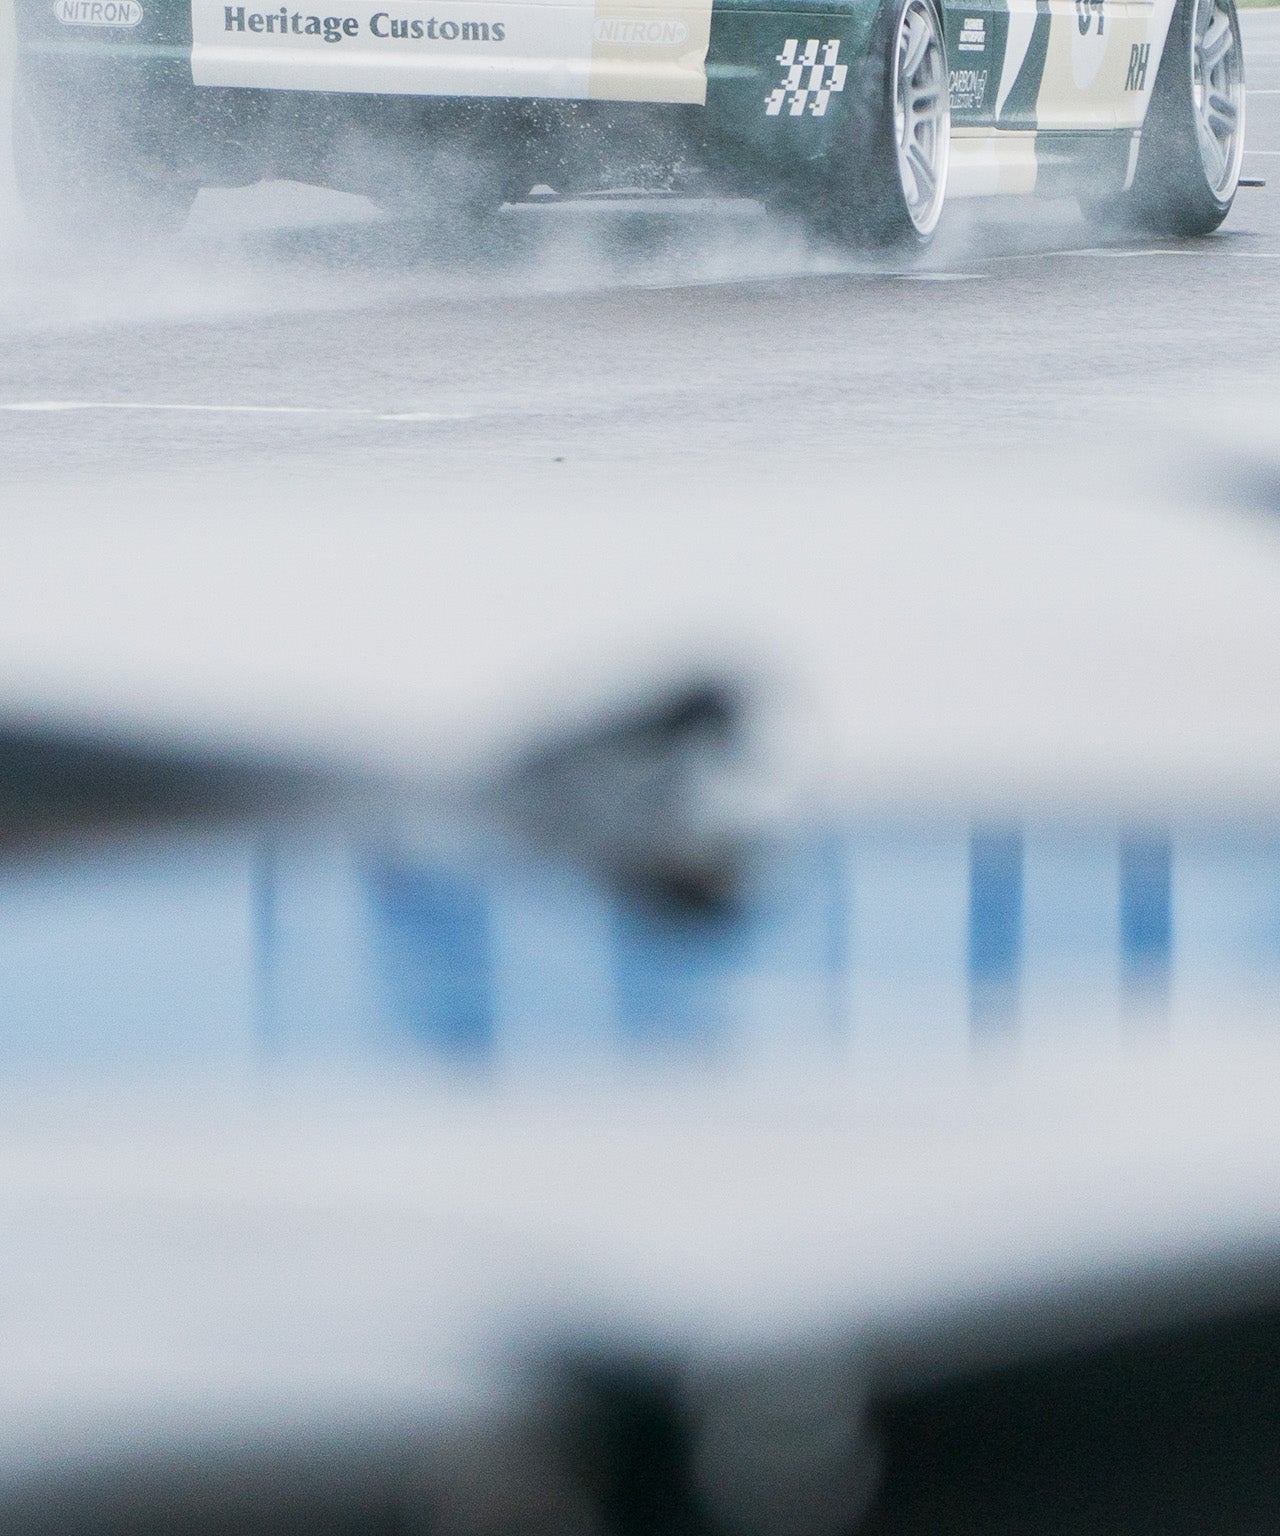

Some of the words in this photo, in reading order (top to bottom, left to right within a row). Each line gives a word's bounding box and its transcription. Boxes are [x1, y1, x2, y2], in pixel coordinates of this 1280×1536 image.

[223, 5, 359, 44] Heritage
[370, 11, 507, 43] Customs
[1124, 42, 1152, 92] RH
